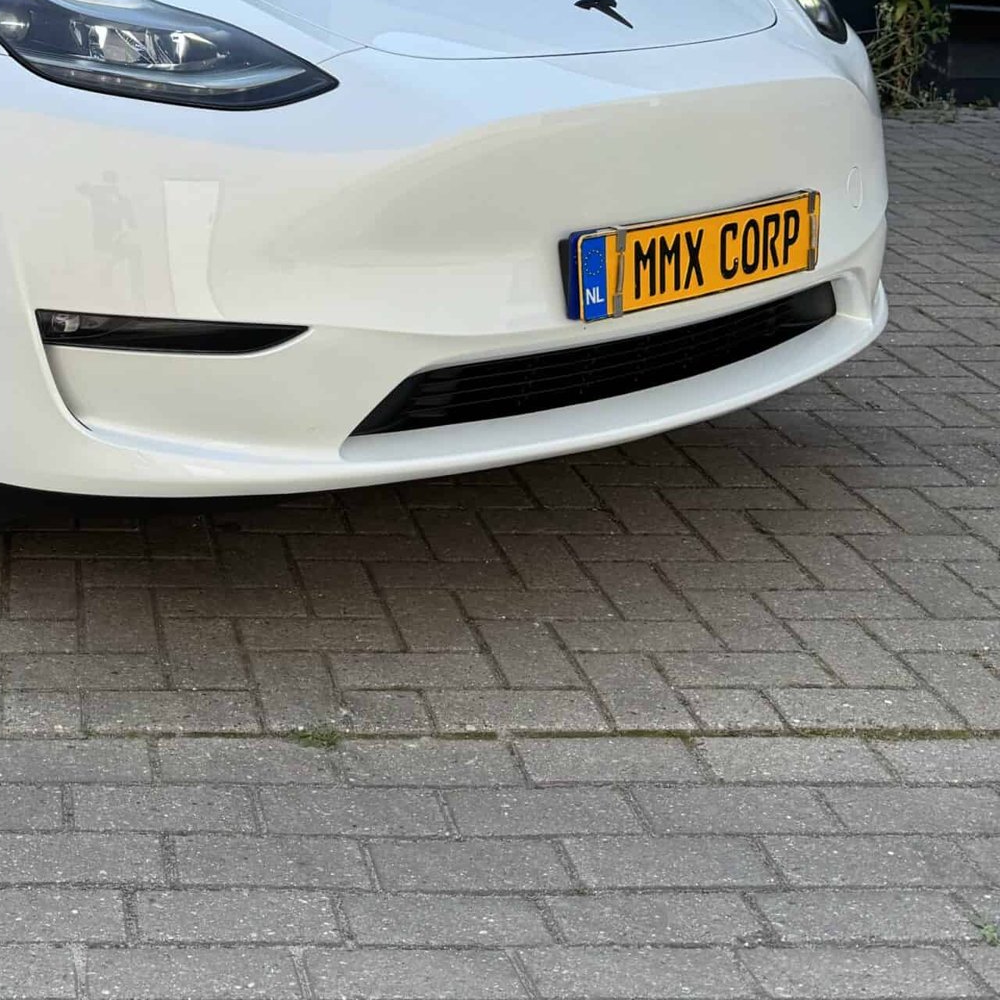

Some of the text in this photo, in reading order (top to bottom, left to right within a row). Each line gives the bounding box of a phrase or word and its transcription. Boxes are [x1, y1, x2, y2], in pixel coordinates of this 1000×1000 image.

[634, 209, 800, 300] MMX CORP
[585, 286, 604, 306] NL
